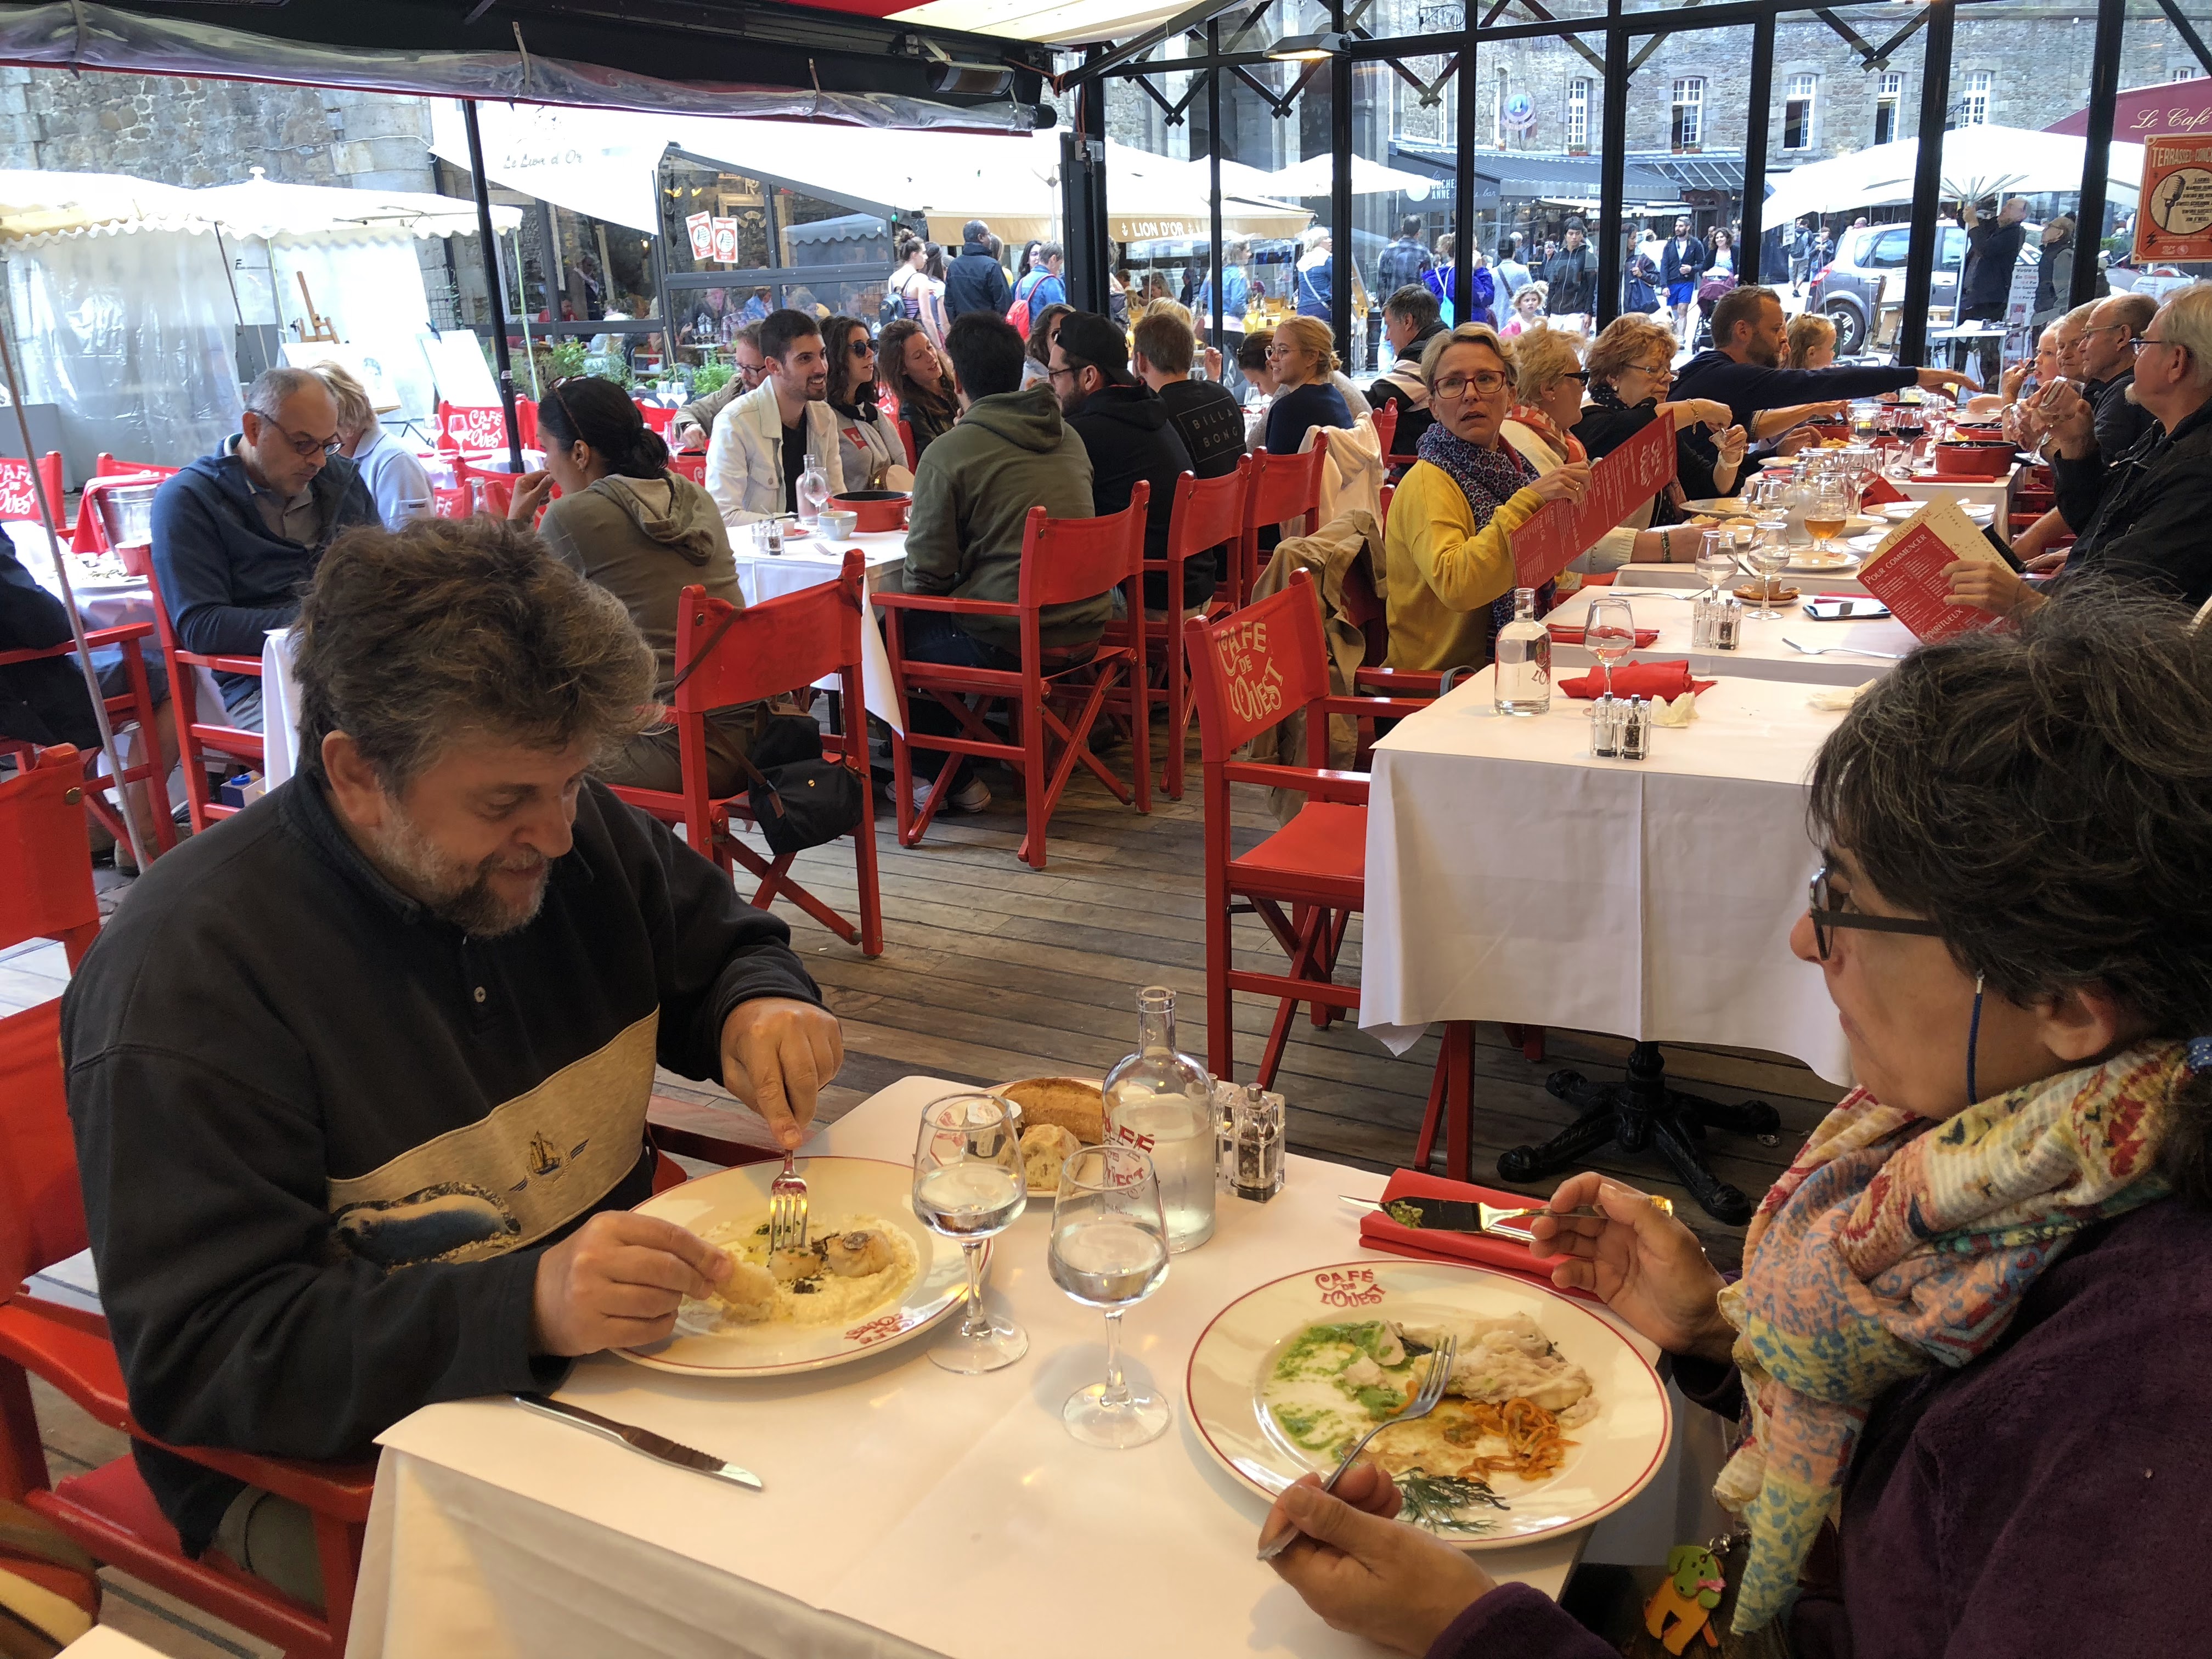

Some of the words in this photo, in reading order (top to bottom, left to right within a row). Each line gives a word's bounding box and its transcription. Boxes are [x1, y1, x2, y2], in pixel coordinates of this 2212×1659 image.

[2130, 109, 2159, 129] Le
[2167, 107, 2212, 132] Café
[1431, 189, 1450, 200] ANNE
[1482, 187, 1497, 197] bar
[1131, 222, 1159, 237] LION
[1160, 222, 1185, 236] D'OR
[469, 409, 503, 429] CAFÉ
[1192, 408, 1233, 430] BILLA
[1203, 426, 1238, 448] BONG
[1885, 534, 1927, 569] COMMENCER
[1217, 616, 1267, 676] CAFÉ
[1238, 654, 1253, 675] DE
[1314, 1268, 1374, 1291] CAFÉ
